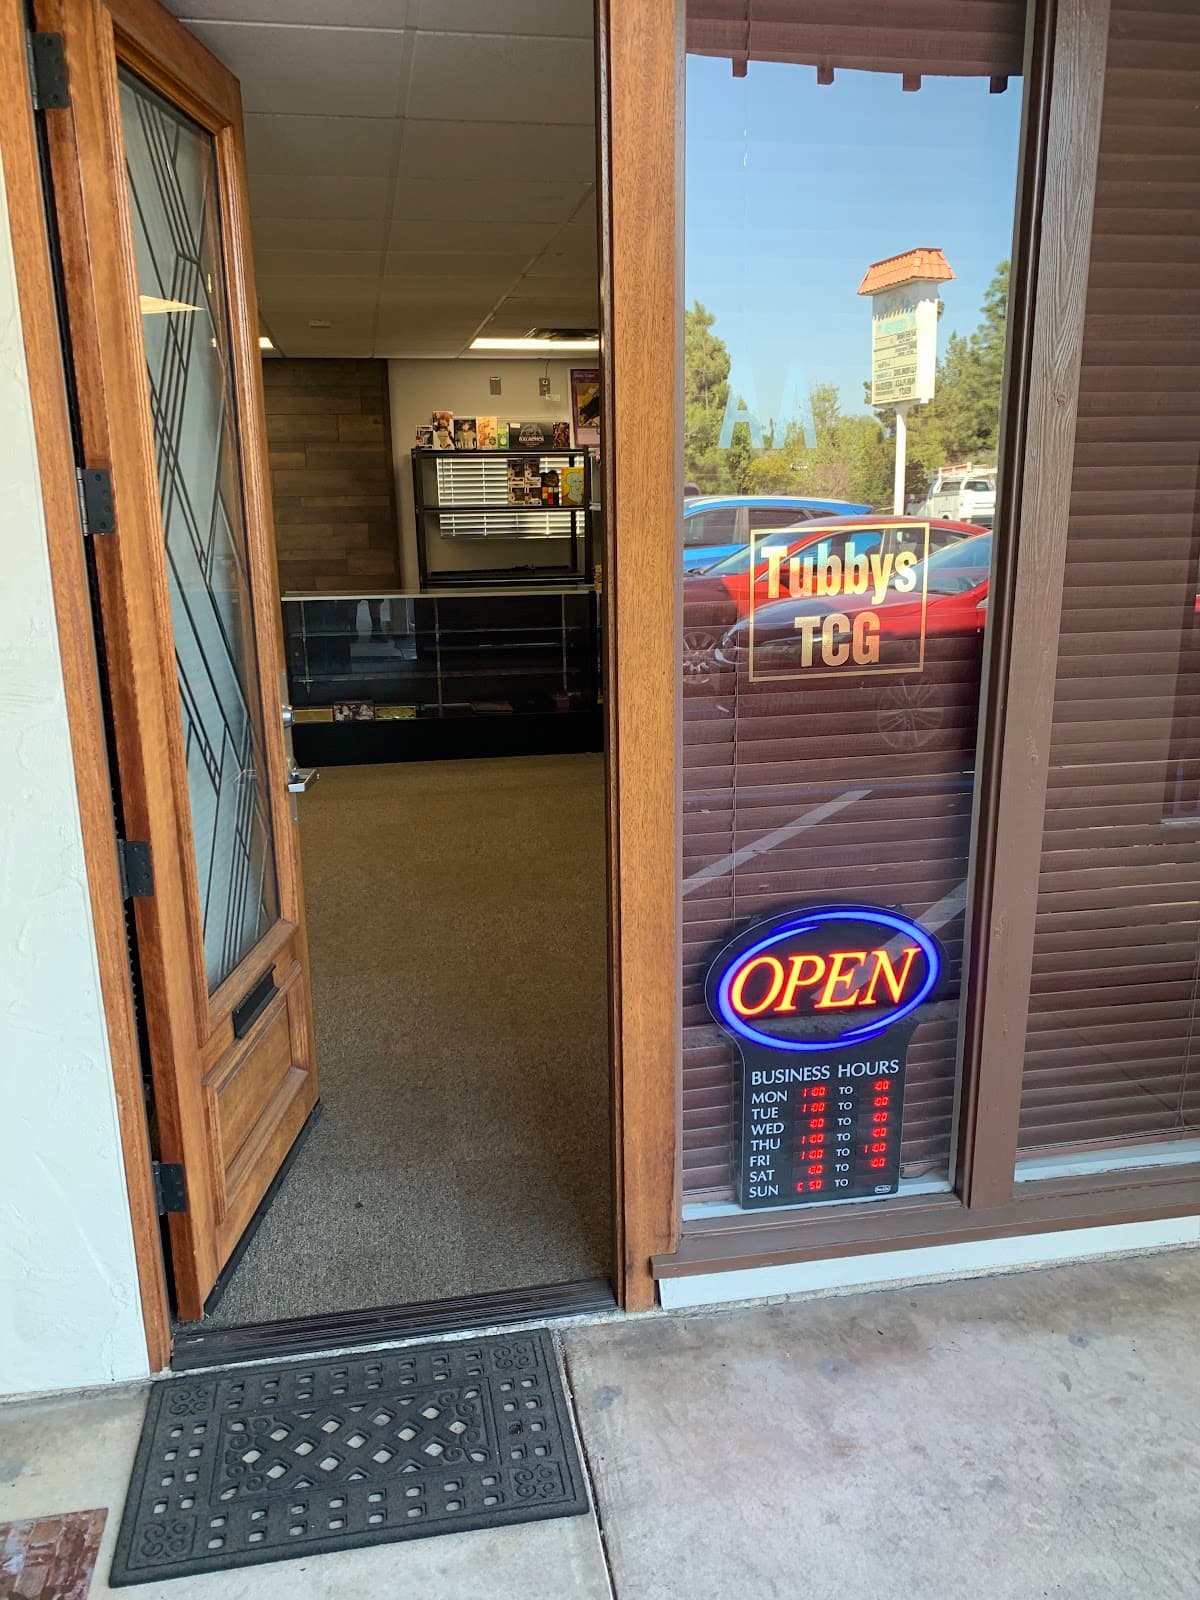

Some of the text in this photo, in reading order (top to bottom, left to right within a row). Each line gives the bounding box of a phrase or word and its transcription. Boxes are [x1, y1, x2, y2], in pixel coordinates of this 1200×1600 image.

[760, 542, 919, 606] Tubbys
[794, 611, 881, 667] TCG
[731, 947, 922, 1016] OPEN
[751, 1059, 900, 1086] BUSINESS HOURS
[751, 1090, 789, 1105] MON
[839, 1085, 854, 1095] TO
[751, 1106, 779, 1121] TUE
[838, 1101, 853, 1111] TO
[751, 1122, 785, 1136] WED
[837, 1117, 852, 1126] TO
[750, 1137, 781, 1152] THU
[836, 1132, 851, 1141] TO
[749, 1154, 770, 1168] FRI
[835, 1147, 850, 1157] TO
[749, 1169, 776, 1183] SAT
[834, 1162, 849, 1172] TO
[748, 1184, 779, 1199] SUN
[834, 1178, 849, 1188] TO
